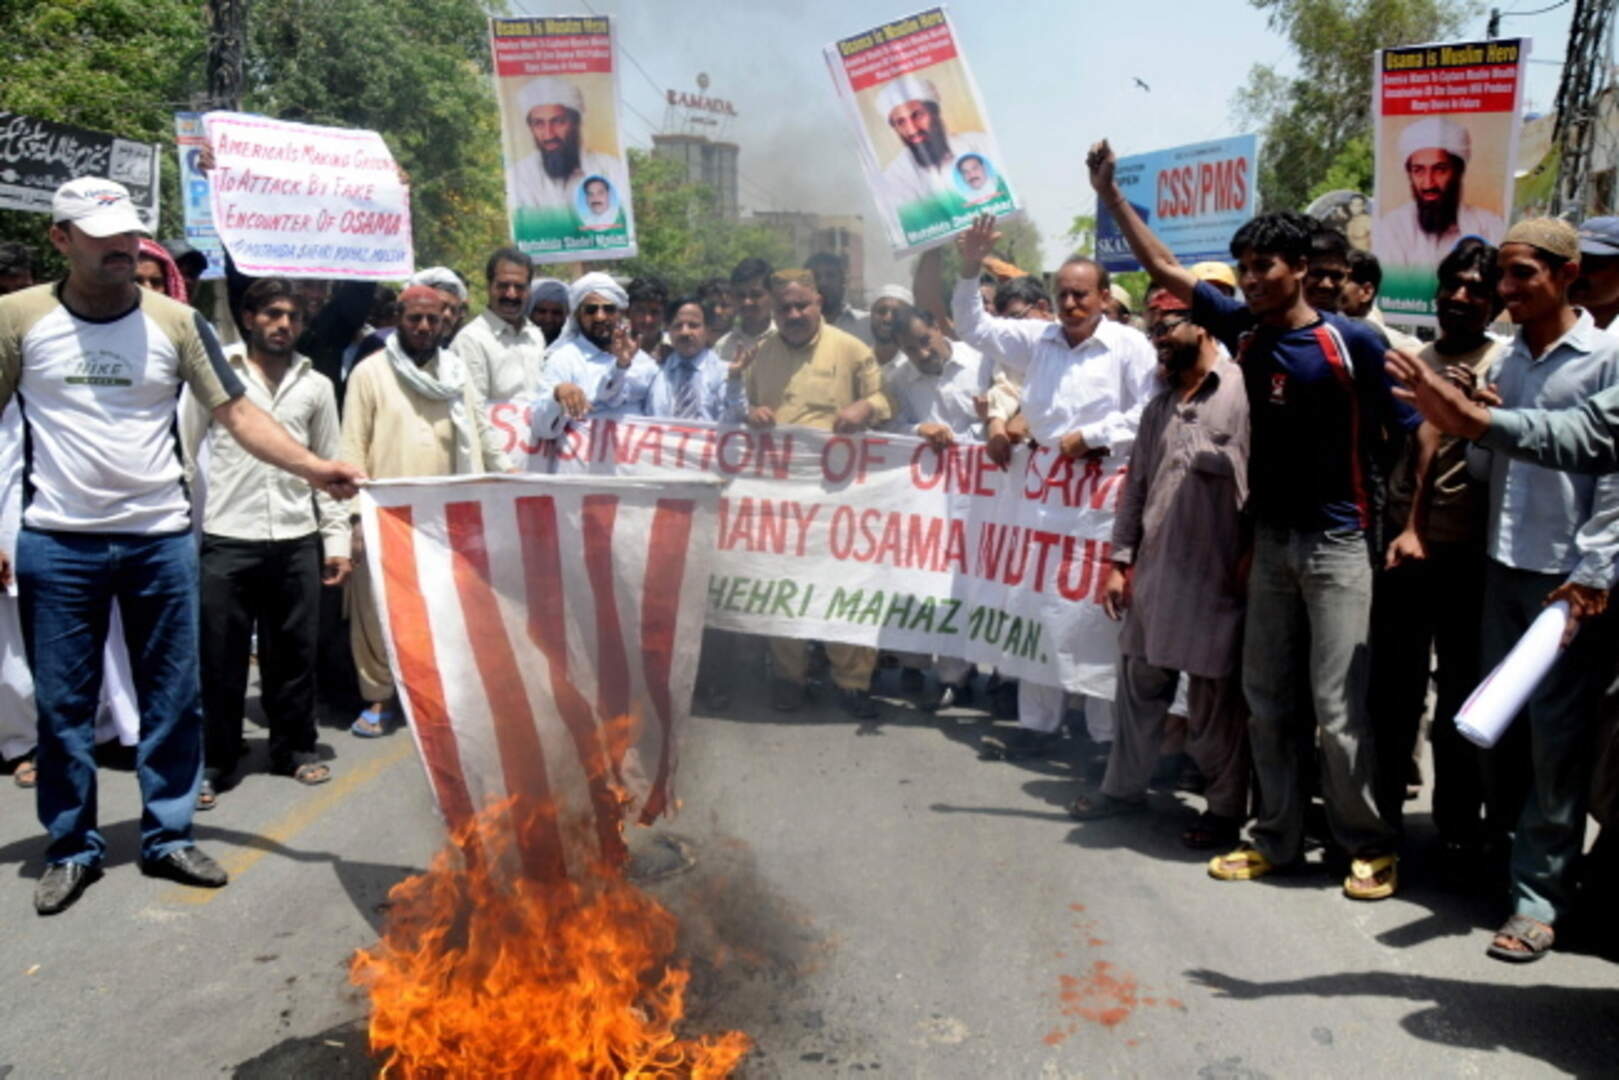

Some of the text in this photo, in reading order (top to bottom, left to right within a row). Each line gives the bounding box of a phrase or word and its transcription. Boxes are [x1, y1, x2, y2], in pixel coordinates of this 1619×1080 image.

[1426, 49, 1438, 67] is
[1440, 46, 1484, 65] Muslim
[1486, 44, 1518, 63] Hero
[665, 88, 738, 117] RAMADA
[1155, 156, 1248, 219] CSS/PMS
[819, 436, 891, 485] OF
[910, 441, 1000, 498] ONE
[829, 504, 969, 576] OSAMA
[823, 585, 963, 634] MAHAZ
